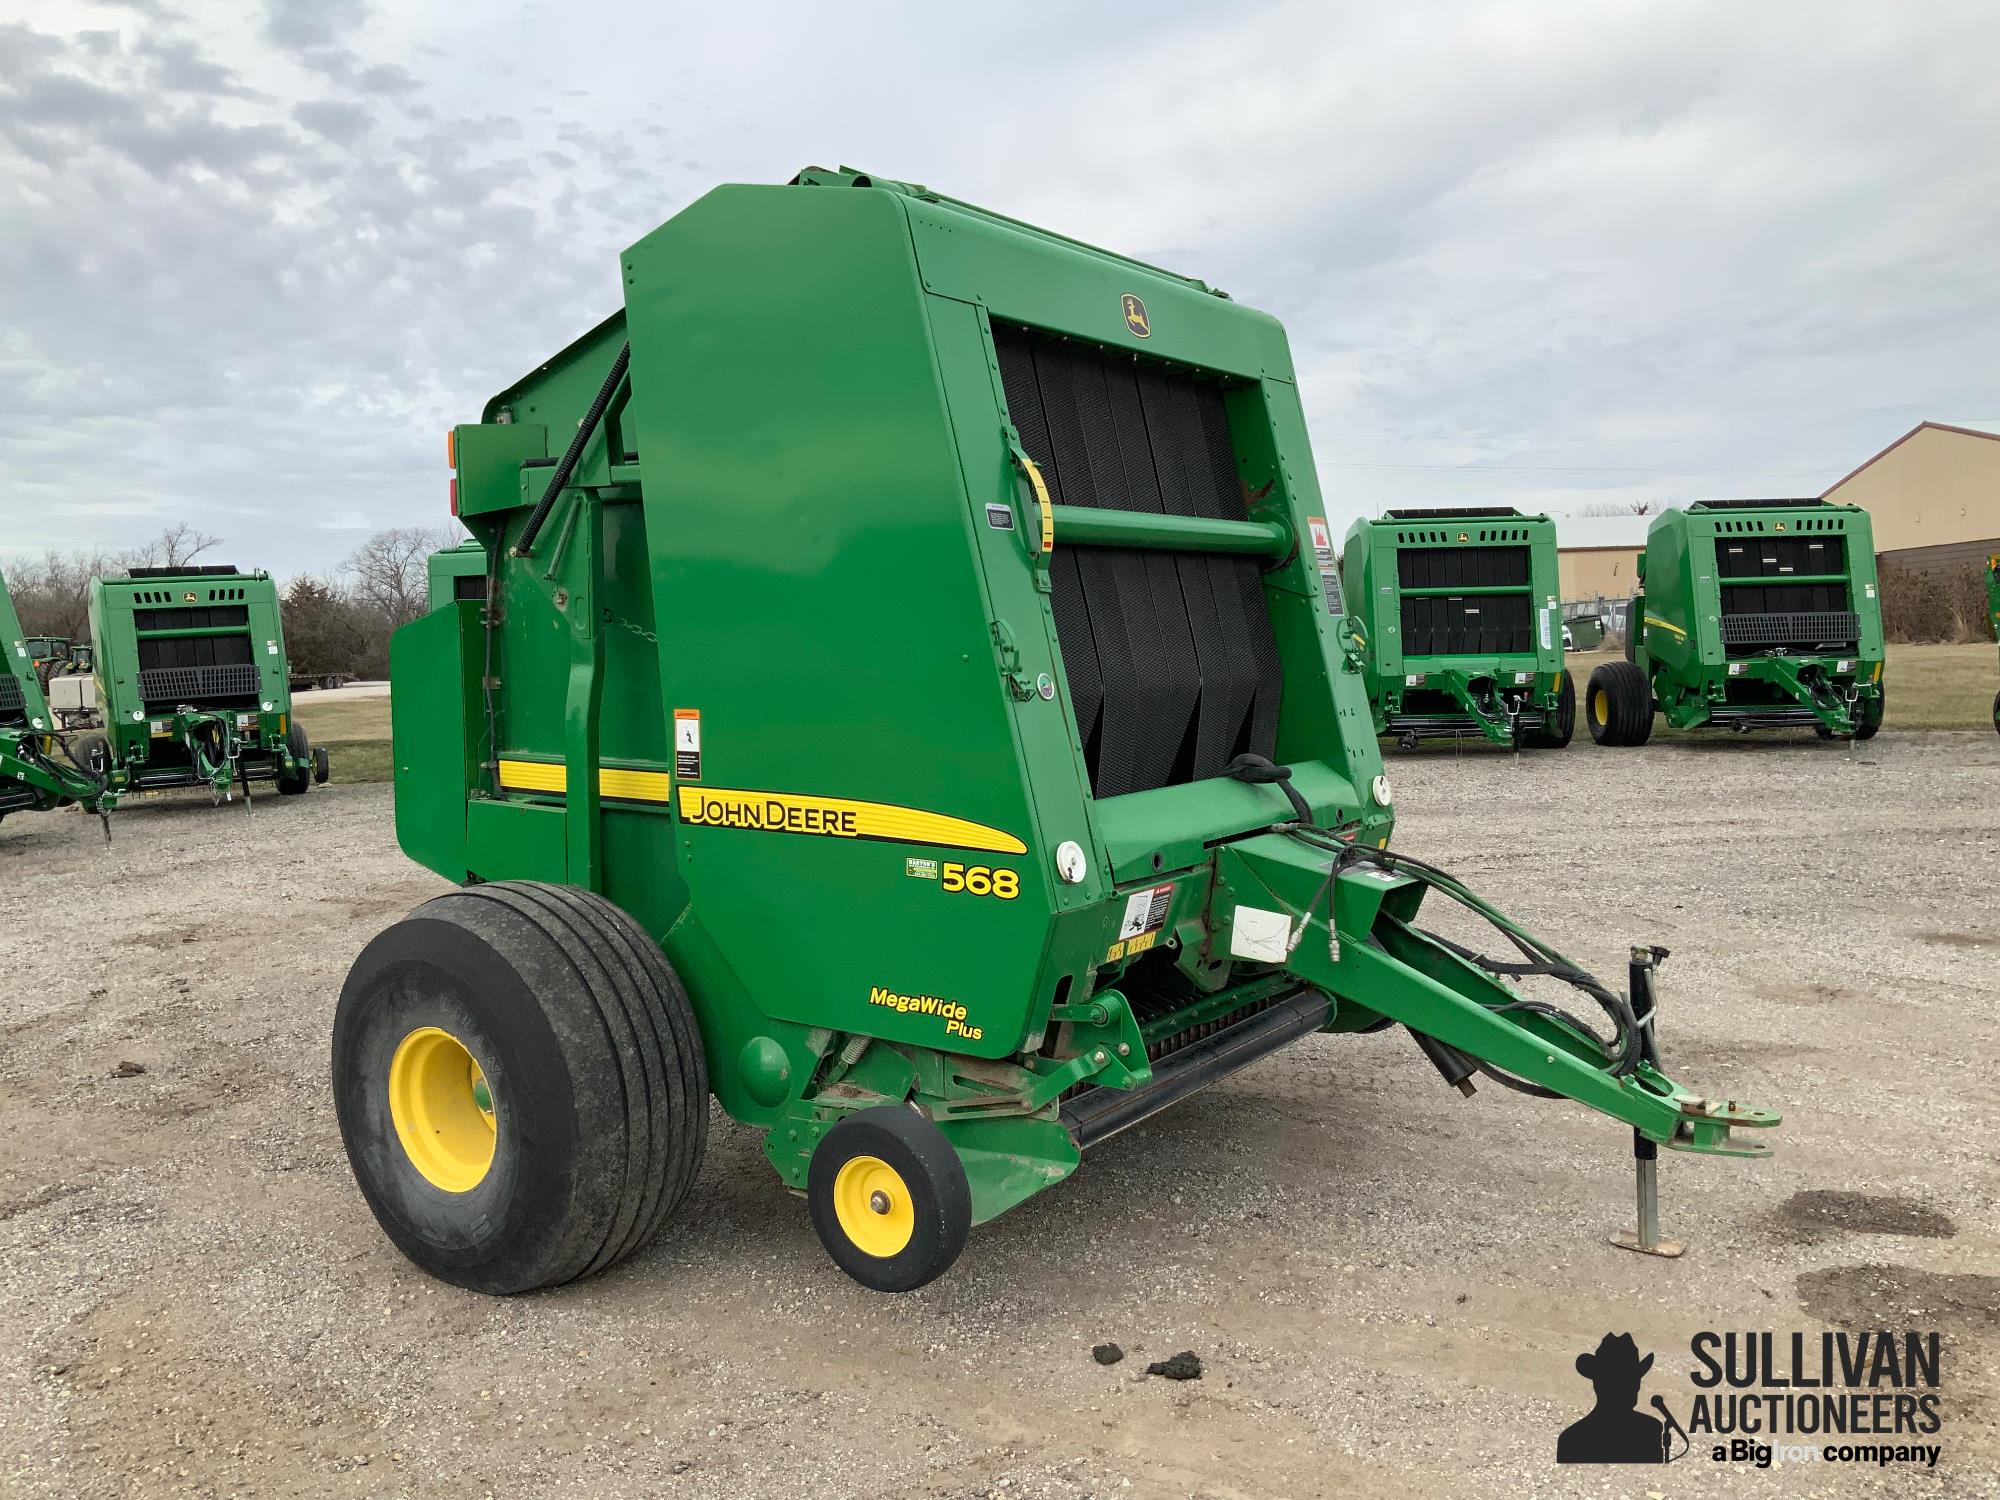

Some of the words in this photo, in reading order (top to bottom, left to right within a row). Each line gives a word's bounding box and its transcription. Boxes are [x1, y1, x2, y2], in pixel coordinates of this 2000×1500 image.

[692, 796, 761, 825] JOHN
[766, 800, 857, 833] DEERE
[943, 862, 1019, 899] 568
[869, 987, 967, 1020] MegaWide
[945, 1020, 982, 1040] Plus
